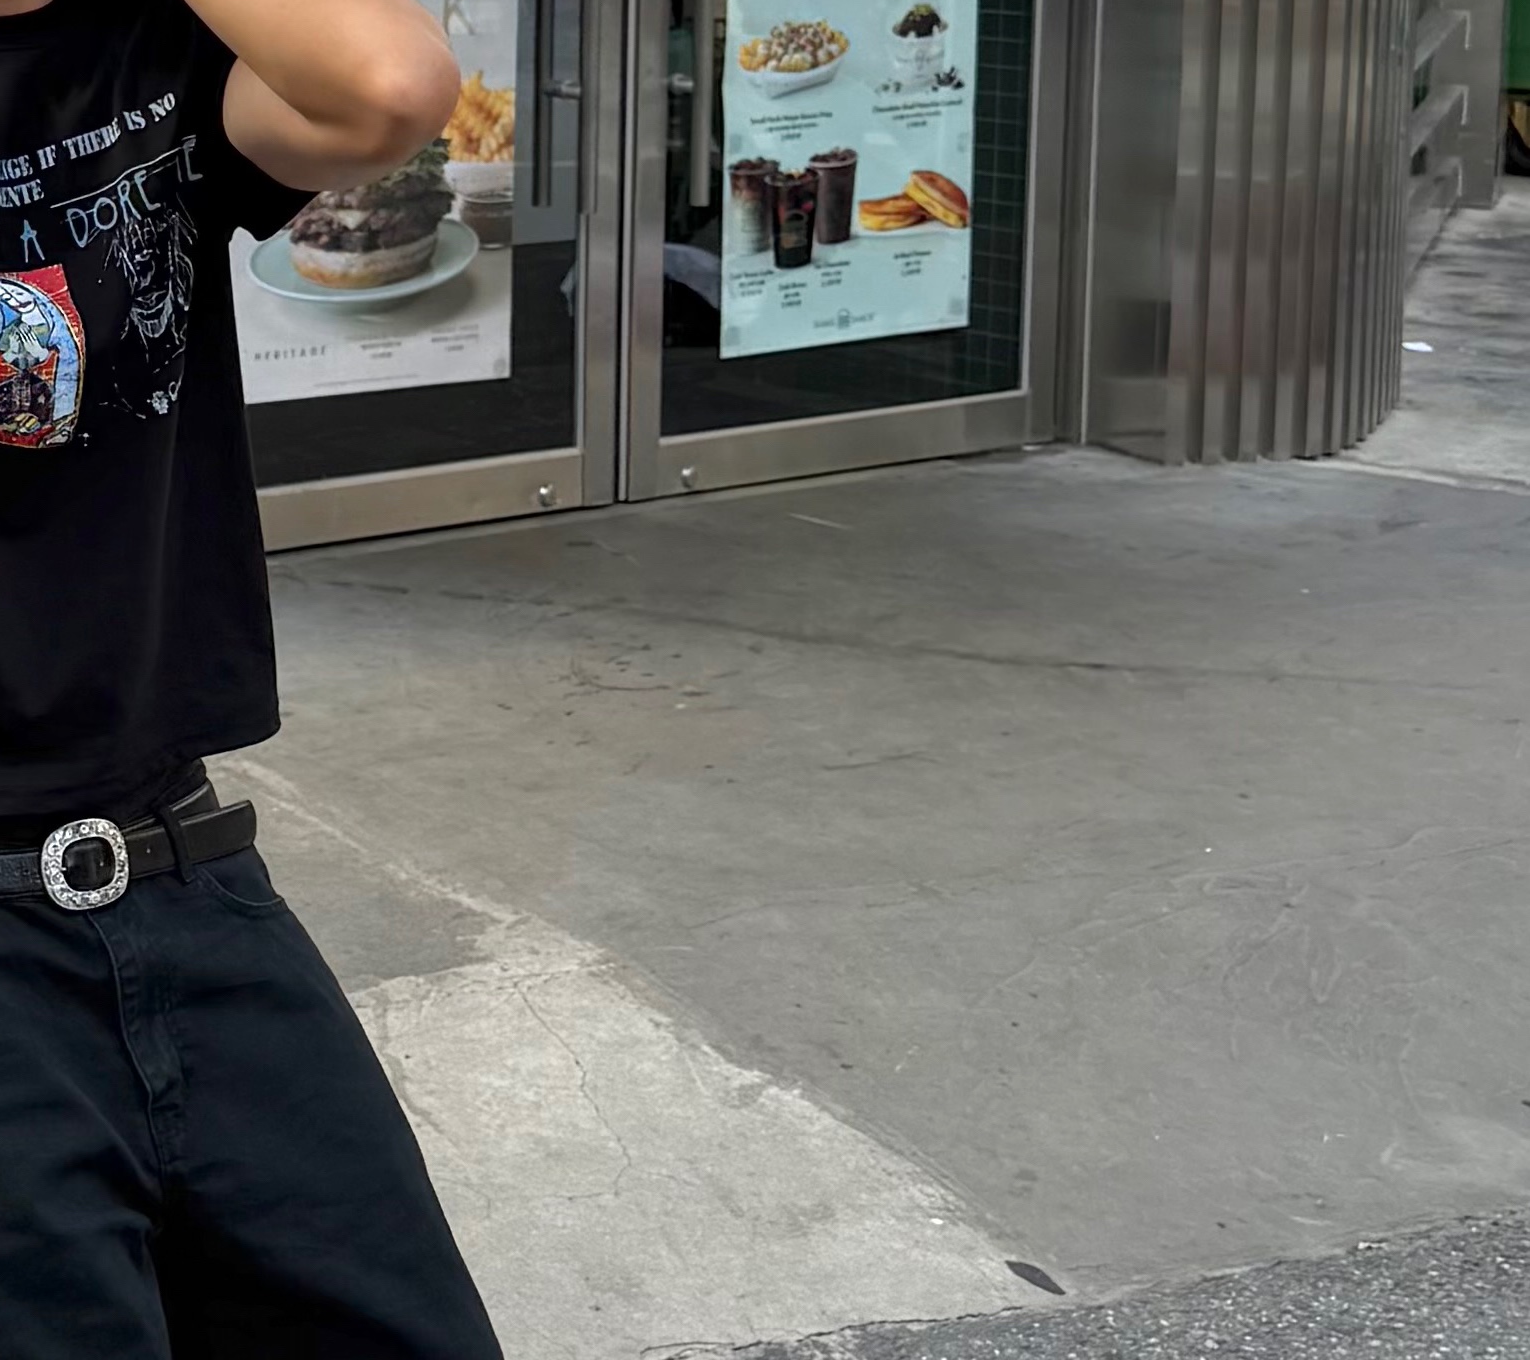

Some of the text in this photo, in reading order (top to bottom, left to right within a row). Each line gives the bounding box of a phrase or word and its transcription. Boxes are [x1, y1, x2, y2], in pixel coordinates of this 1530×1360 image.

[36, 144, 57, 170] IF
[62, 117, 121, 160] THERE
[123, 110, 146, 131] IS
[147, 92, 176, 123] NO
